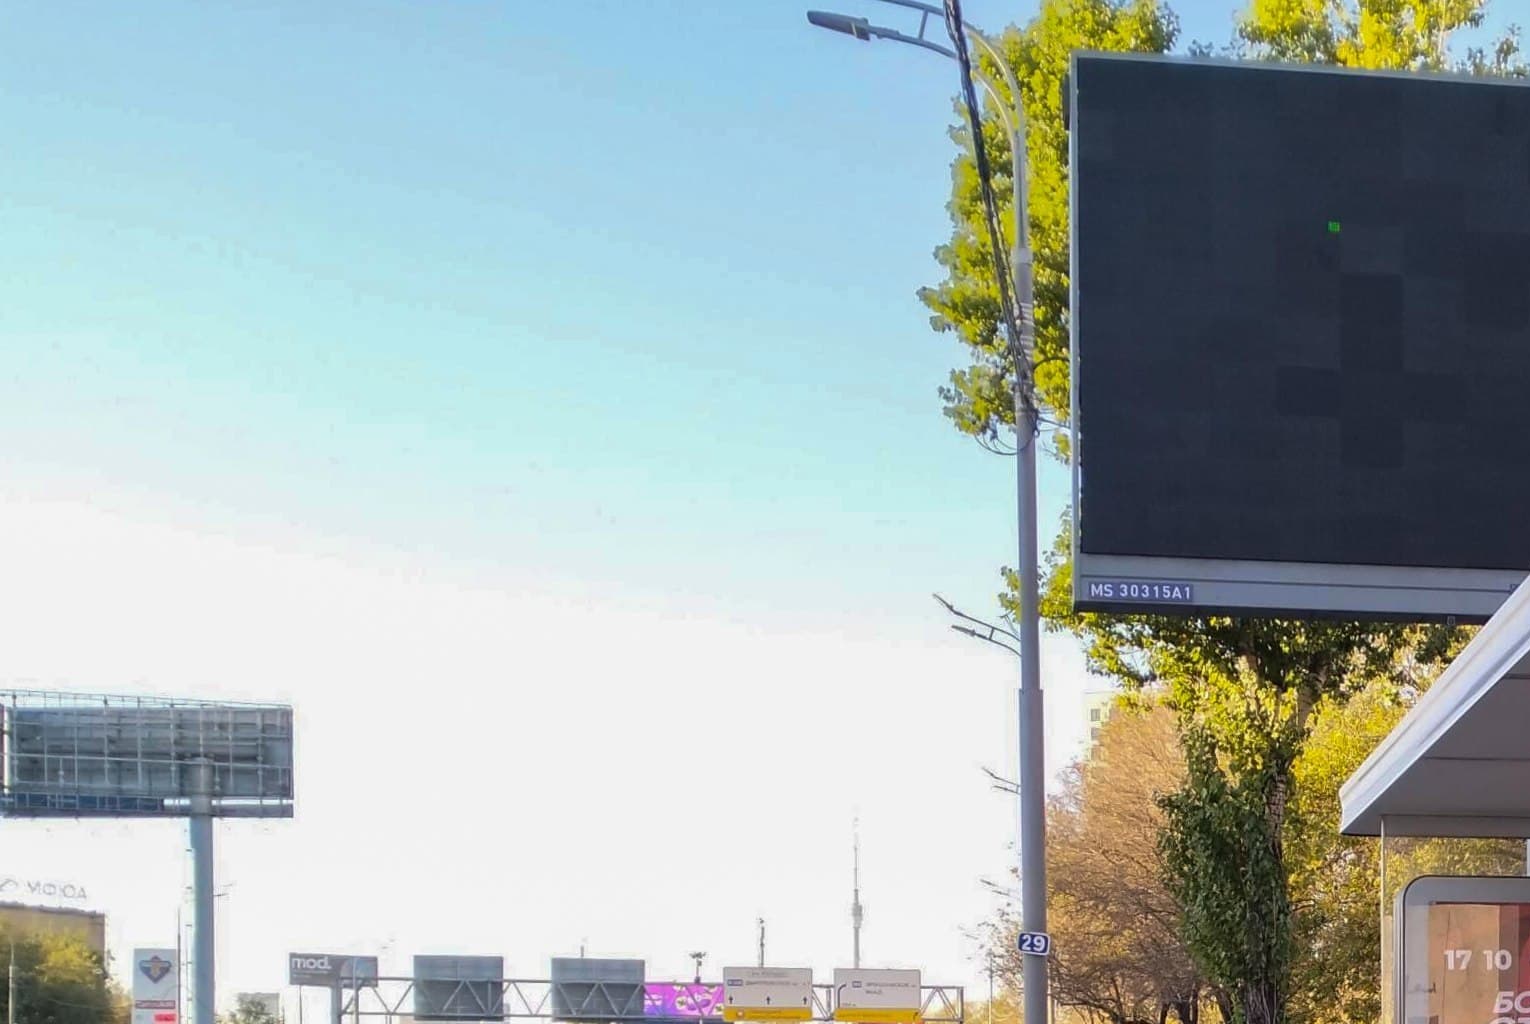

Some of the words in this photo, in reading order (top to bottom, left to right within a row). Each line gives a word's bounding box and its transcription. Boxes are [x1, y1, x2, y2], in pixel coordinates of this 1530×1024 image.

[1090, 584, 1113, 597] MS
[1119, 584, 1190, 599] 30315A1
[1021, 934, 1045, 952] 29
[1444, 949, 1472, 971] 17
[1483, 949, 1512, 971] 10
